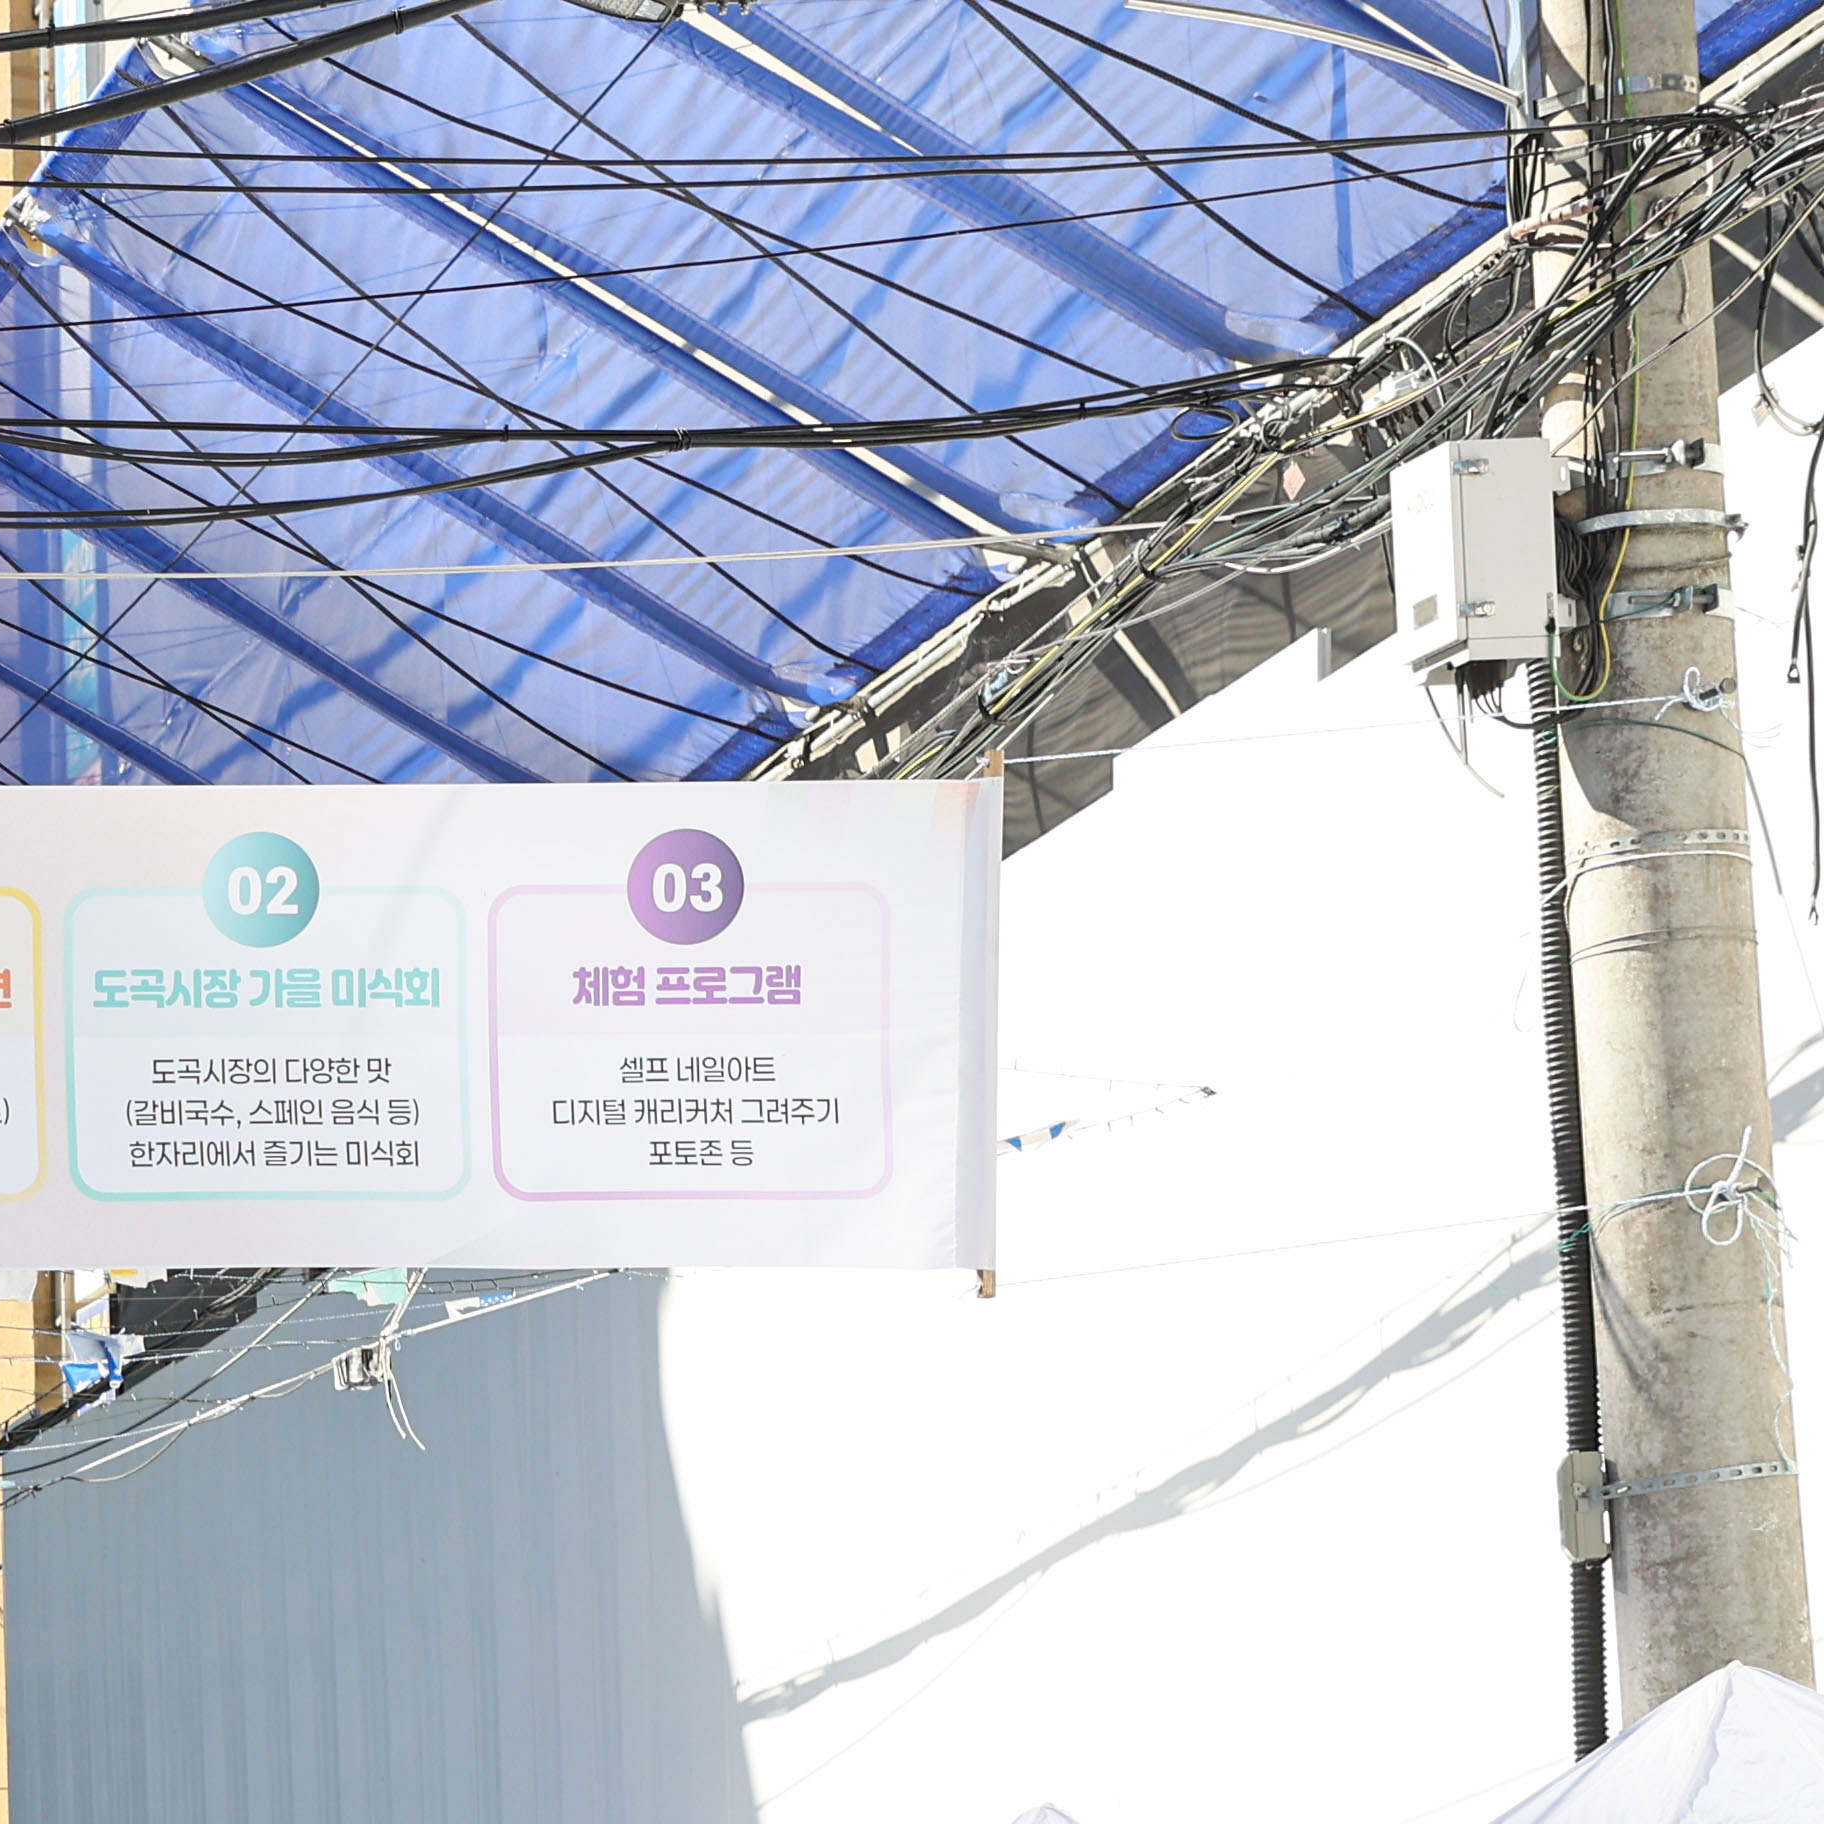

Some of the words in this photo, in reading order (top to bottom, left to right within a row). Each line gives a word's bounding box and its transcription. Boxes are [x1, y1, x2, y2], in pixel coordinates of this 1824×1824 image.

[227, 866, 300, 916] 02
[651, 861, 725, 914] 03
[92, 967, 242, 1010] 도곡시장
[249, 967, 322, 1010] 가을
[331, 967, 441, 1009] 미식회
[572, 965, 646, 1008] 체험
[655, 964, 803, 1007] 프로그램
[151, 1057, 278, 1086] 도곡시장의
[284, 1057, 360, 1086] 다양한
[366, 1057, 392, 1086] 맛
[619, 1055, 670, 1084] 셀프
[676, 1055, 777, 1084] 네일아트
[125, 1098, 243, 1129] (갈비국수,
[248, 1098, 324, 1127] 스페인
[330, 1098, 381, 1127] 음식
[387, 1098, 421, 1128] 등)
[551, 1098, 627, 1127] 디지털
[634, 1097, 734, 1127] 캐리커처
[740, 1096, 840, 1127] 그려주기
[129, 1140, 256, 1168] 한자리에서
[263, 1140, 339, 1168] 즐기는
[345, 1140, 421, 1168] 미식회
[647, 1139, 724, 1168] 포토존
[730, 1139, 755, 1168] 등
